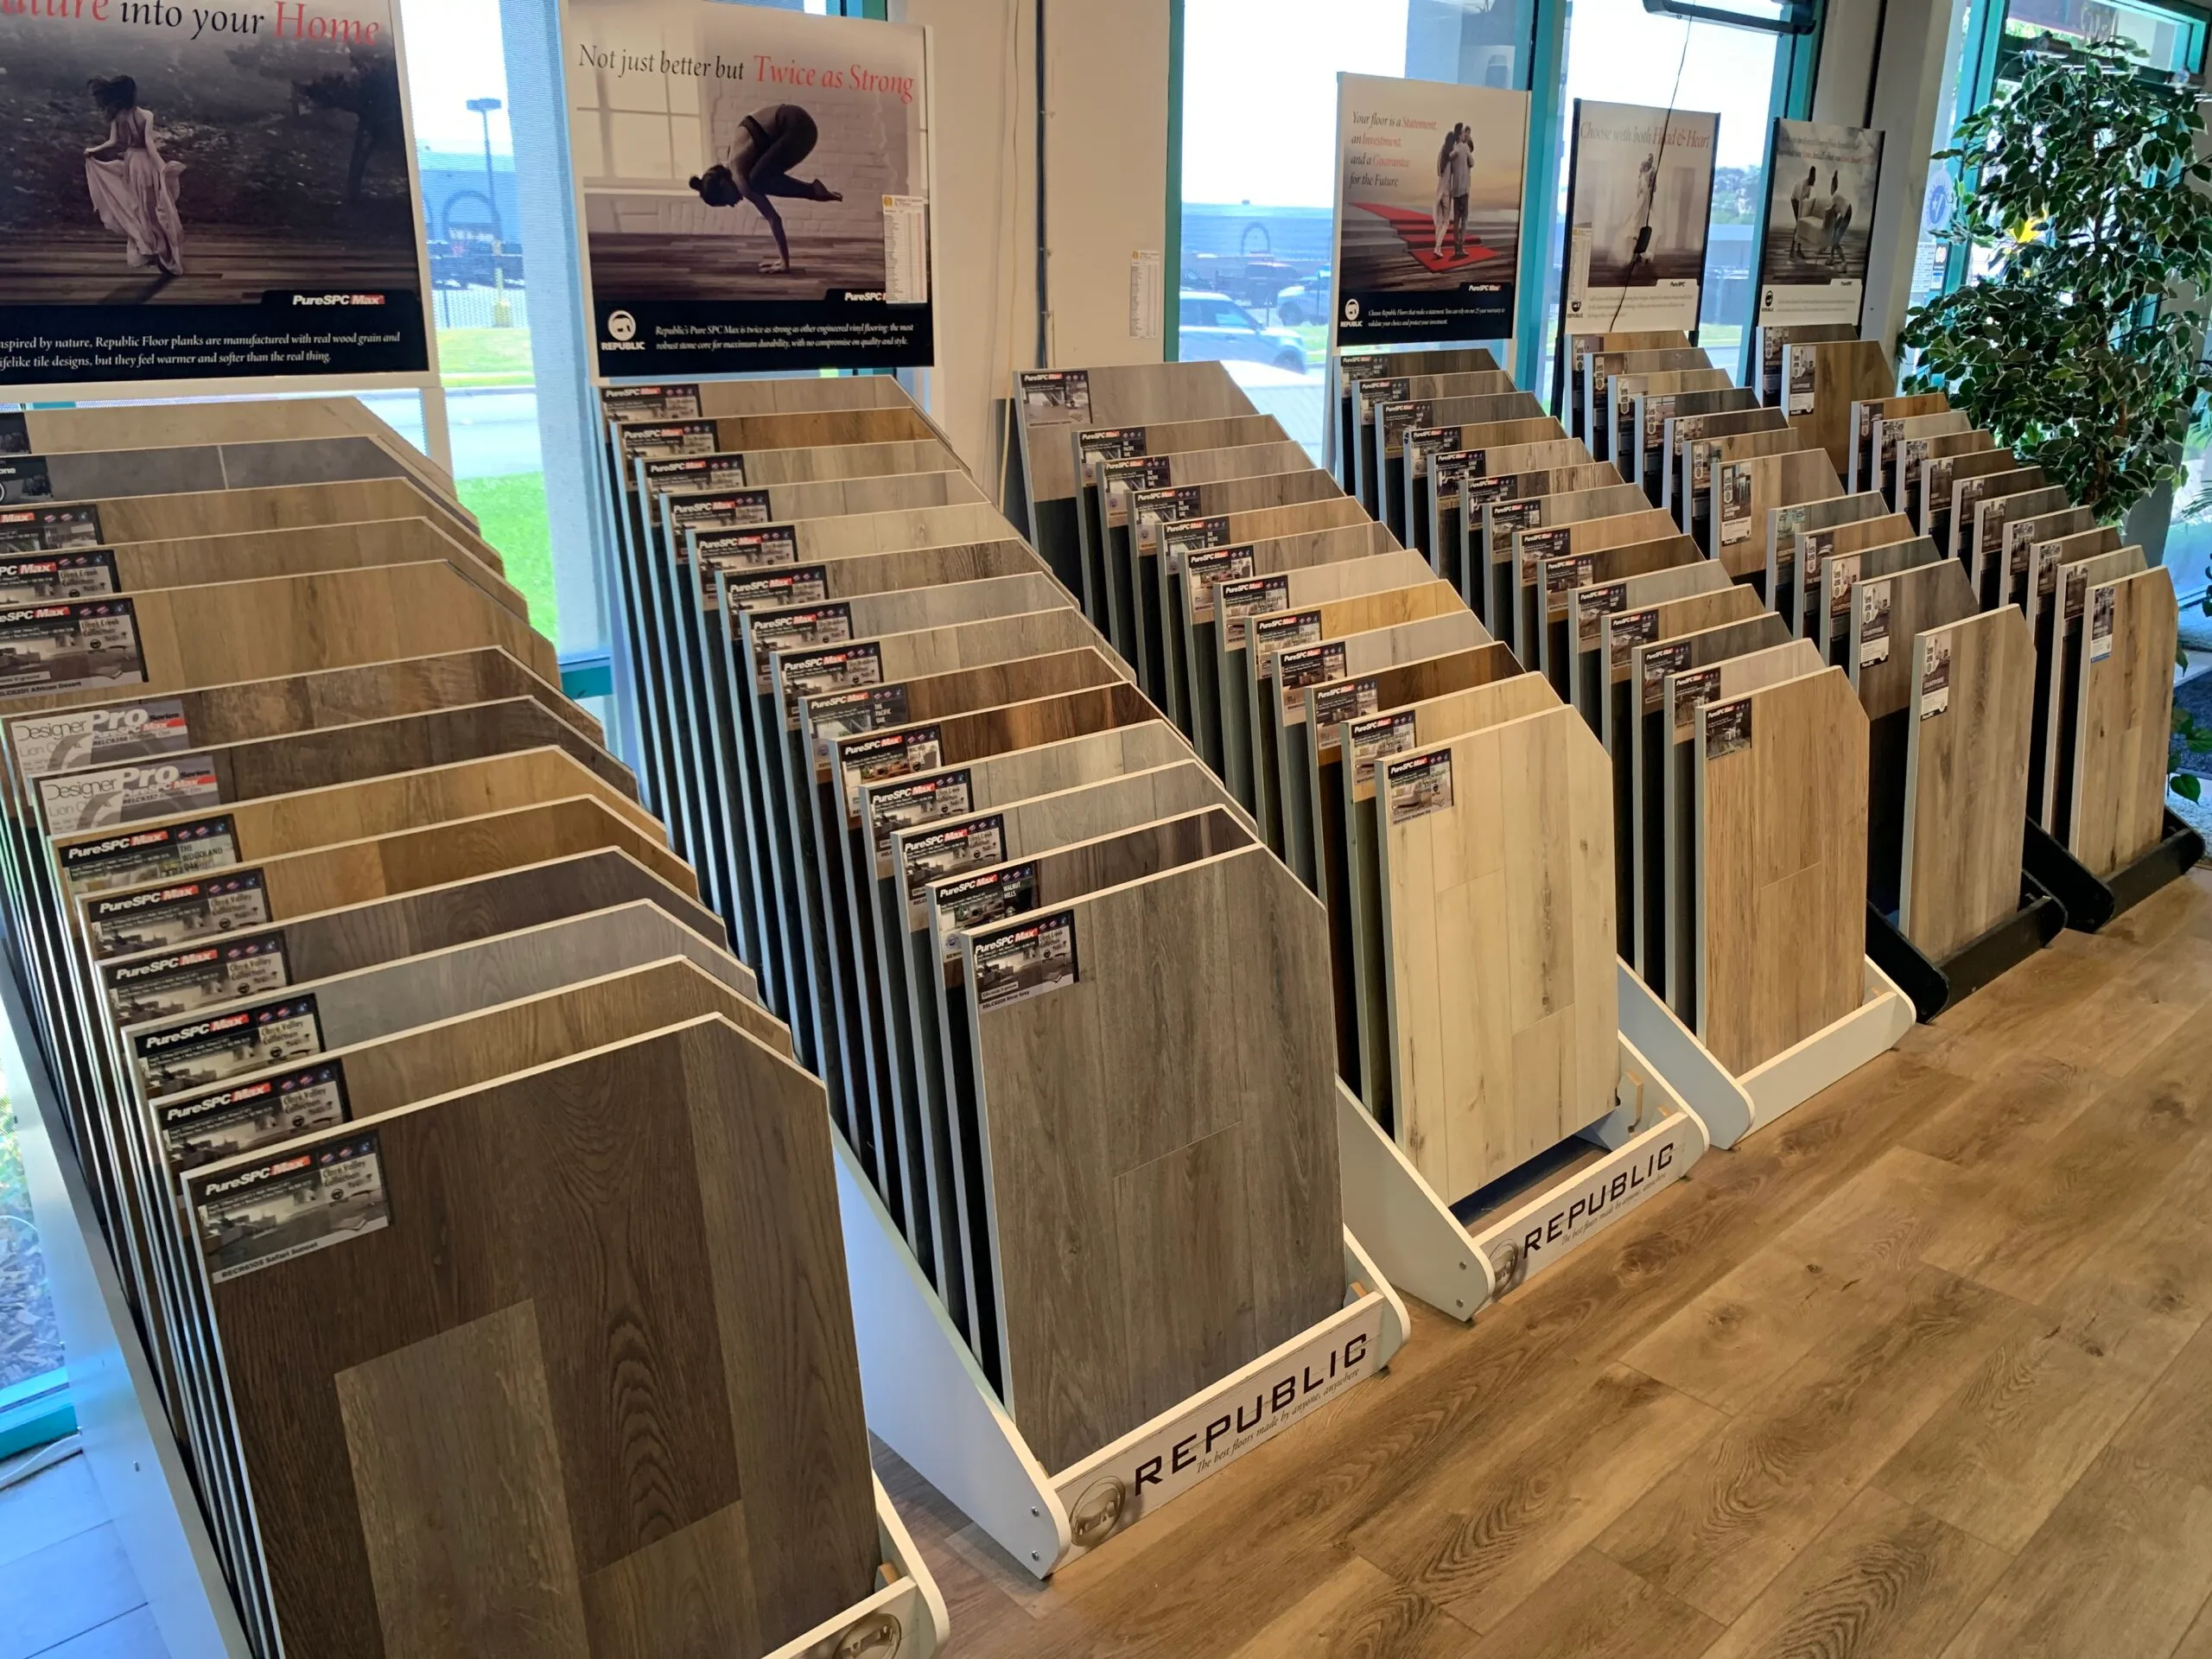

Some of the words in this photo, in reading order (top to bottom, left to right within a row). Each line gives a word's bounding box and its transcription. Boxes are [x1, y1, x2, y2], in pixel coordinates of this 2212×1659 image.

[120, 0, 181, 27] into
[191, 9, 264, 40] your
[275, 1, 380, 46] Home
[579, 43, 616, 70] Not
[618, 49, 654, 78] just
[660, 49, 712, 78] better
[715, 55, 744, 80] but
[754, 54, 816, 87] Twice
[822, 67, 843, 88] as
[849, 63, 915, 104] Strong
[1353, 111, 1370, 124] Your
[1369, 112, 1388, 129] floor
[1389, 114, 1395, 126] is
[1351, 135, 1361, 144] an
[1580, 121, 1610, 141] Choose
[1613, 126, 1631, 142] with
[1632, 126, 1651, 144] both
[1677, 130, 1686, 146] &
[1686, 130, 1711, 149] Heart
[1351, 152, 1366, 165] and
[1348, 172, 1361, 188] for
[1362, 173, 1372, 186] the
[1375, 174, 1399, 187] Future
[293, 295, 349, 305] PureSPC
[351, 296, 380, 305] Max
[844, 292, 881, 302] PureSPC
[655, 325, 689, 338] Republic's
[690, 326, 706, 334] Pure
[708, 326, 722, 334] SPC
[724, 326, 740, 334] Max
[747, 325, 764, 334] twice
[772, 326, 792, 336] strong
[800, 323, 816, 333] other
[817, 324, 849, 335] engineered
[849, 323, 864, 334] vinyl
[890, 323, 899, 332] the
[40, 337, 51, 351] by
[55, 338, 92, 349] nature,
[95, 335, 140, 350] Republic
[142, 334, 169, 346] Floor
[171, 334, 204, 349] planks
[206, 337, 221, 346] are
[224, 334, 289, 348] manufactured
[291, 334, 312, 344] with
[313, 333, 331, 344] real
[333, 333, 357, 343] wood
[358, 334, 381, 346] grain
[383, 332, 400, 342] and
[601, 341, 645, 351] REPUBLIC
[657, 341, 678, 350] robust
[712, 340, 721, 352] for
[723, 340, 757, 349] maximum
[791, 338, 805, 346] with
[815, 339, 852, 349] compromise
[861, 336, 880, 347] quality
[34, 356, 49, 367] tile
[52, 355, 92, 370] designs,
[95, 354, 111, 365] but
[115, 353, 137, 368] they
[137, 353, 155, 368] feel
[156, 355, 196, 365] warmer
[198, 353, 217, 363] and
[219, 352, 245, 365] softer
[246, 352, 269, 362] than
[270, 351, 285, 361] the
[287, 351, 304, 361] real
[306, 351, 331, 363] thing.
[651, 463, 685, 473] PureSPC
[674, 503, 713, 513] PureSPC
[699, 537, 738, 549] PureSPC
[20, 563, 50, 575] Max
[730, 581, 768, 593] PureSPC
[1225, 583, 1249, 594] PureSPC
[36, 607, 65, 619] Max
[754, 618, 792, 630] PureSPC
[792, 615, 814, 625] Max
[784, 658, 823, 671] PureSPC
[823, 655, 844, 666] Max
[810, 696, 847, 709] PureSPC
[14, 721, 86, 741] Designer
[90, 709, 148, 732] Pro
[149, 712, 180, 721] Series
[20, 743, 44, 757] Lion
[845, 741, 881, 755] PureSPC
[881, 736, 900, 747] Max
[1390, 762, 1413, 774] PureSPC
[45, 779, 117, 801] Designer
[123, 766, 179, 791] Pro
[181, 769, 211, 778] Series
[873, 787, 912, 804] PureSPC
[912, 783, 934, 796] Max
[48, 803, 73, 817] Lion
[68, 837, 130, 859] PureSPC
[131, 832, 162, 847] Max
[905, 835, 944, 852] PureSPC
[944, 830, 967, 842] Max
[940, 880, 976, 898] PureSPC
[976, 874, 995, 887] Max
[1003, 881, 1021, 893] WALNUT
[99, 893, 161, 914] PureSPC
[162, 887, 193, 901] Max
[1004, 890, 1016, 899] HILLS
[975, 934, 1014, 955] PureSPC
[1014, 929, 1037, 943] Max
[116, 957, 179, 980] PureSPC
[180, 951, 211, 966] Max
[146, 1023, 210, 1048] PureSPC
[211, 1015, 244, 1032] Max
[168, 1093, 232, 1121] PureSPC
[232, 1084, 265, 1102] Max
[206, 1167, 270, 1196] PureSPC
[270, 1159, 305, 1175] Max
[1523, 1142, 1674, 1260] REPUBLIC
[265, 1251, 289, 1263] Safari
[1135, 1333, 1367, 1496] REPUBLIC
[1198, 1458, 1211, 1473] The
[1214, 1446, 1230, 1462] best
[1230, 1432, 1254, 1457] floors
[1256, 1416, 1279, 1436] made
[1281, 1409, 1290, 1423] by
[1324, 1369, 1360, 1395] anywhere
